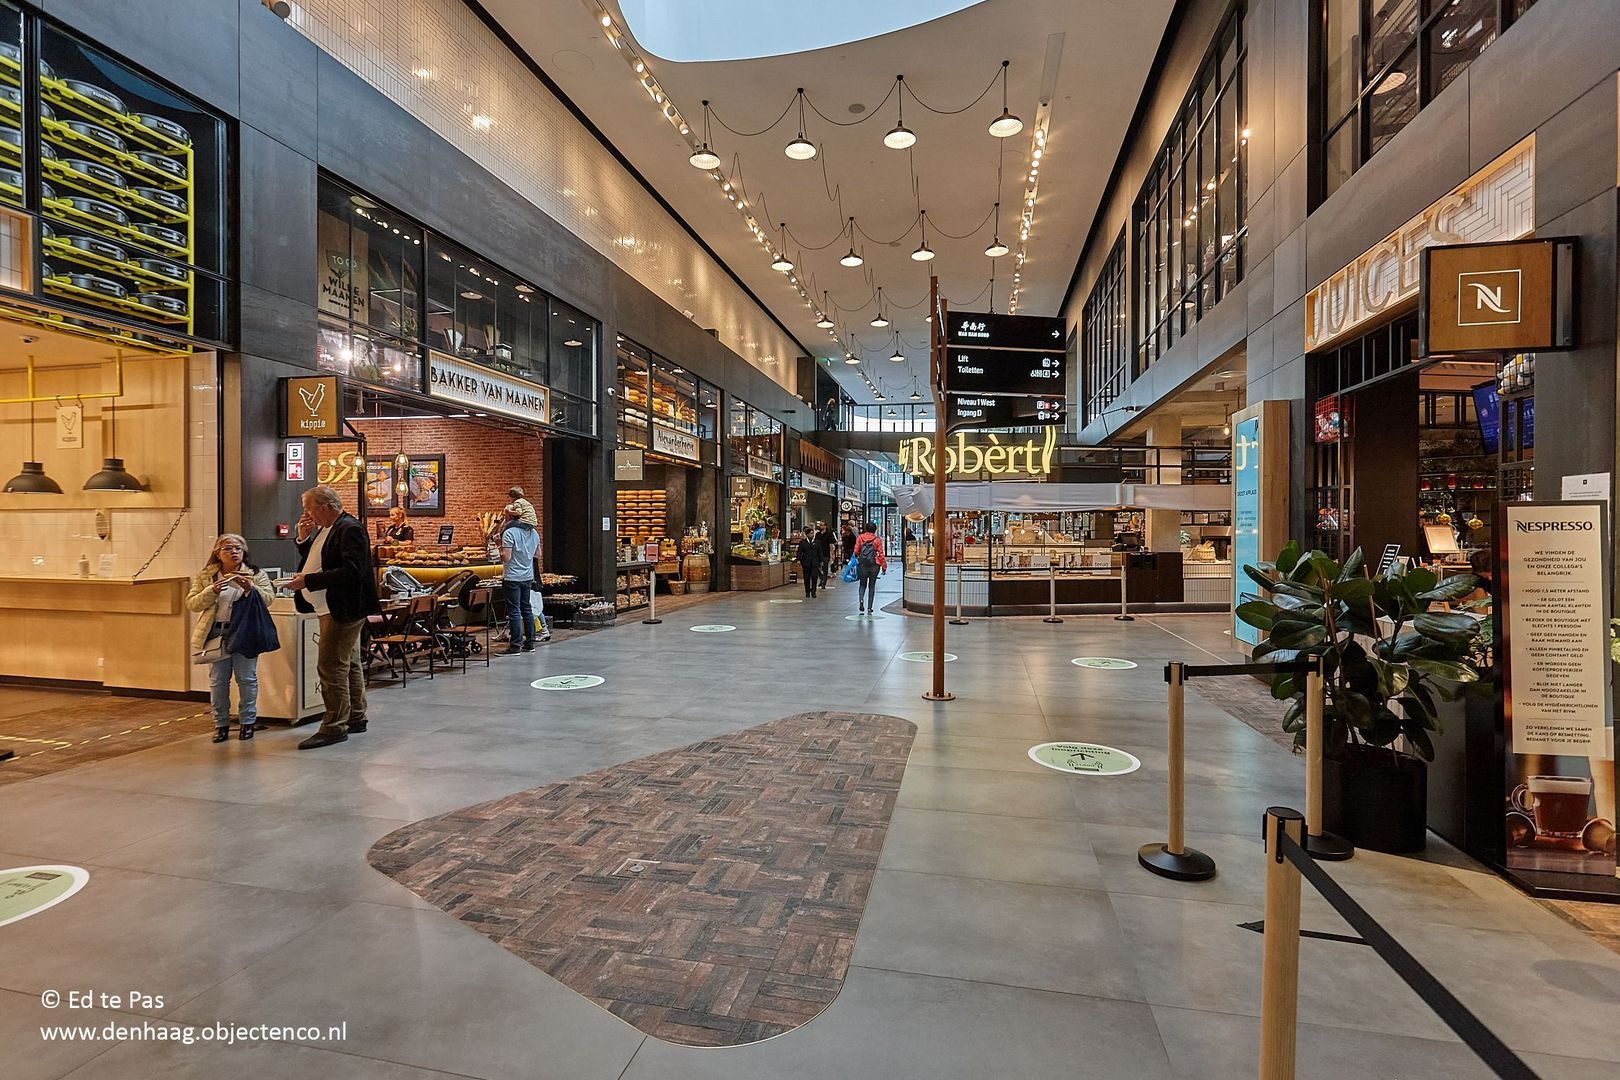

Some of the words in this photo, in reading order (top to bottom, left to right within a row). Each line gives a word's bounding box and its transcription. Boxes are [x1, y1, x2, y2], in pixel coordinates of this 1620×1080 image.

[958, 355, 969, 363] Lift
[958, 366, 983, 374] Toiletten
[431, 367, 478, 394] BAKKER
[481, 381, 502, 401] VAN
[506, 388, 544, 412] MAANEN
[958, 398, 977, 406] Niveau
[981, 399, 995, 407] West
[958, 409, 977, 418] Ingang
[301, 420, 326, 430] kippie
[293, 449, 299, 457] B
[910, 432, 1040, 476] Robèrt
[1515, 520, 1593, 533] NESPRESSO
